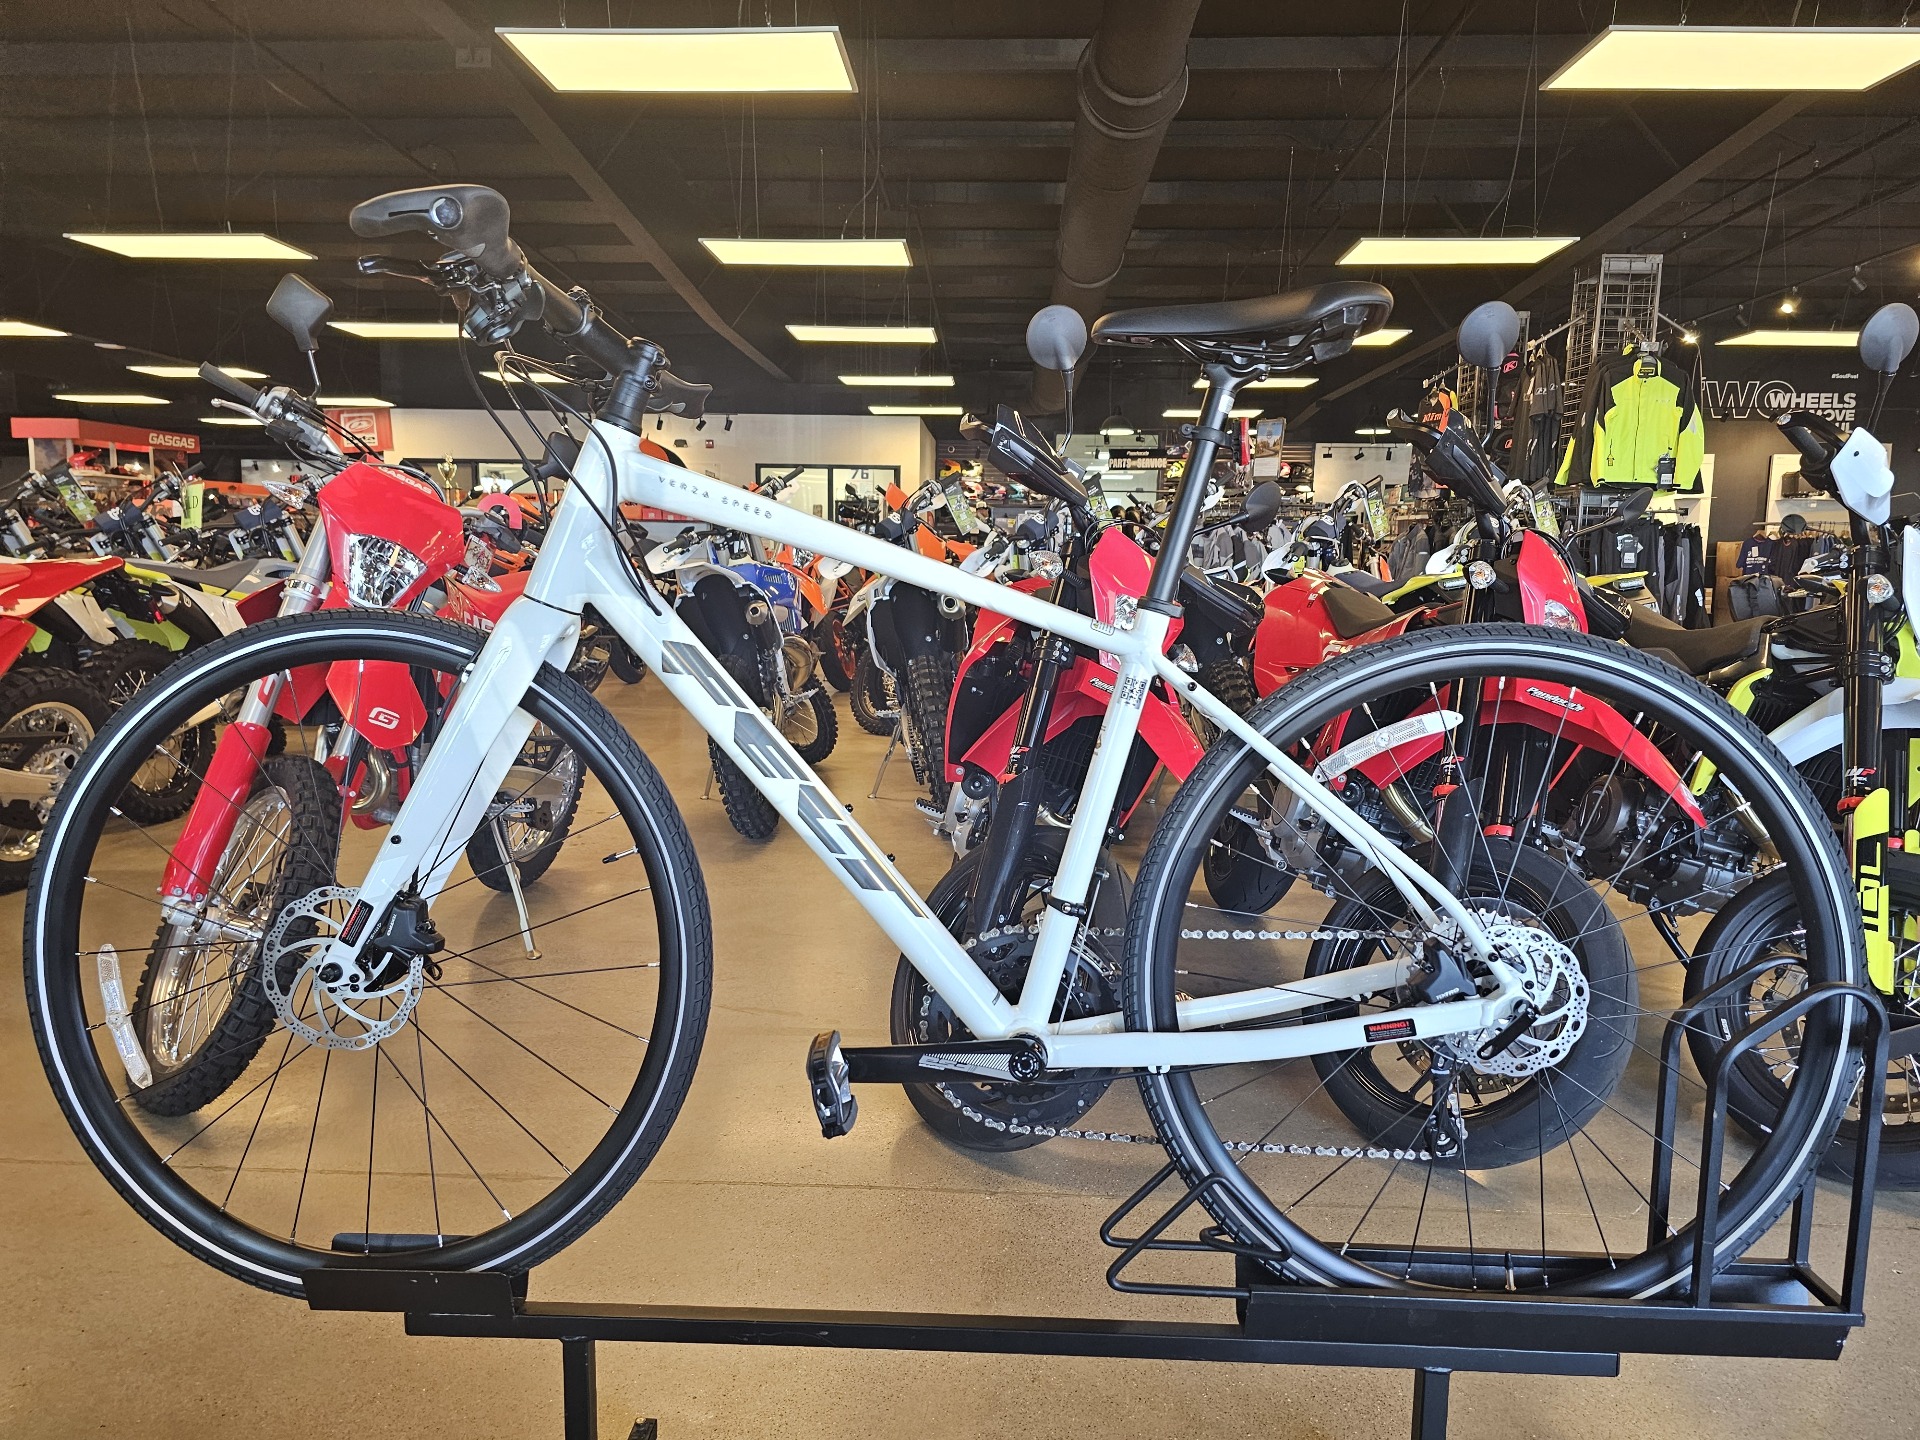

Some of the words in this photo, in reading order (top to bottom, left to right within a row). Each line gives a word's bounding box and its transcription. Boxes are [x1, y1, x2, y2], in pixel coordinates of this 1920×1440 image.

[1769, 392, 1857, 409] WHEELS
[149, 433, 196, 449] GASGAS
[1109, 458, 1132, 468] PARTS
[1137, 458, 1167, 468] SERVICE
[658, 475, 710, 499] VERZA
[721, 495, 772, 519] SPEED
[662, 640, 930, 919] FELT
[1368, 1021, 1410, 1032] WARNING!
